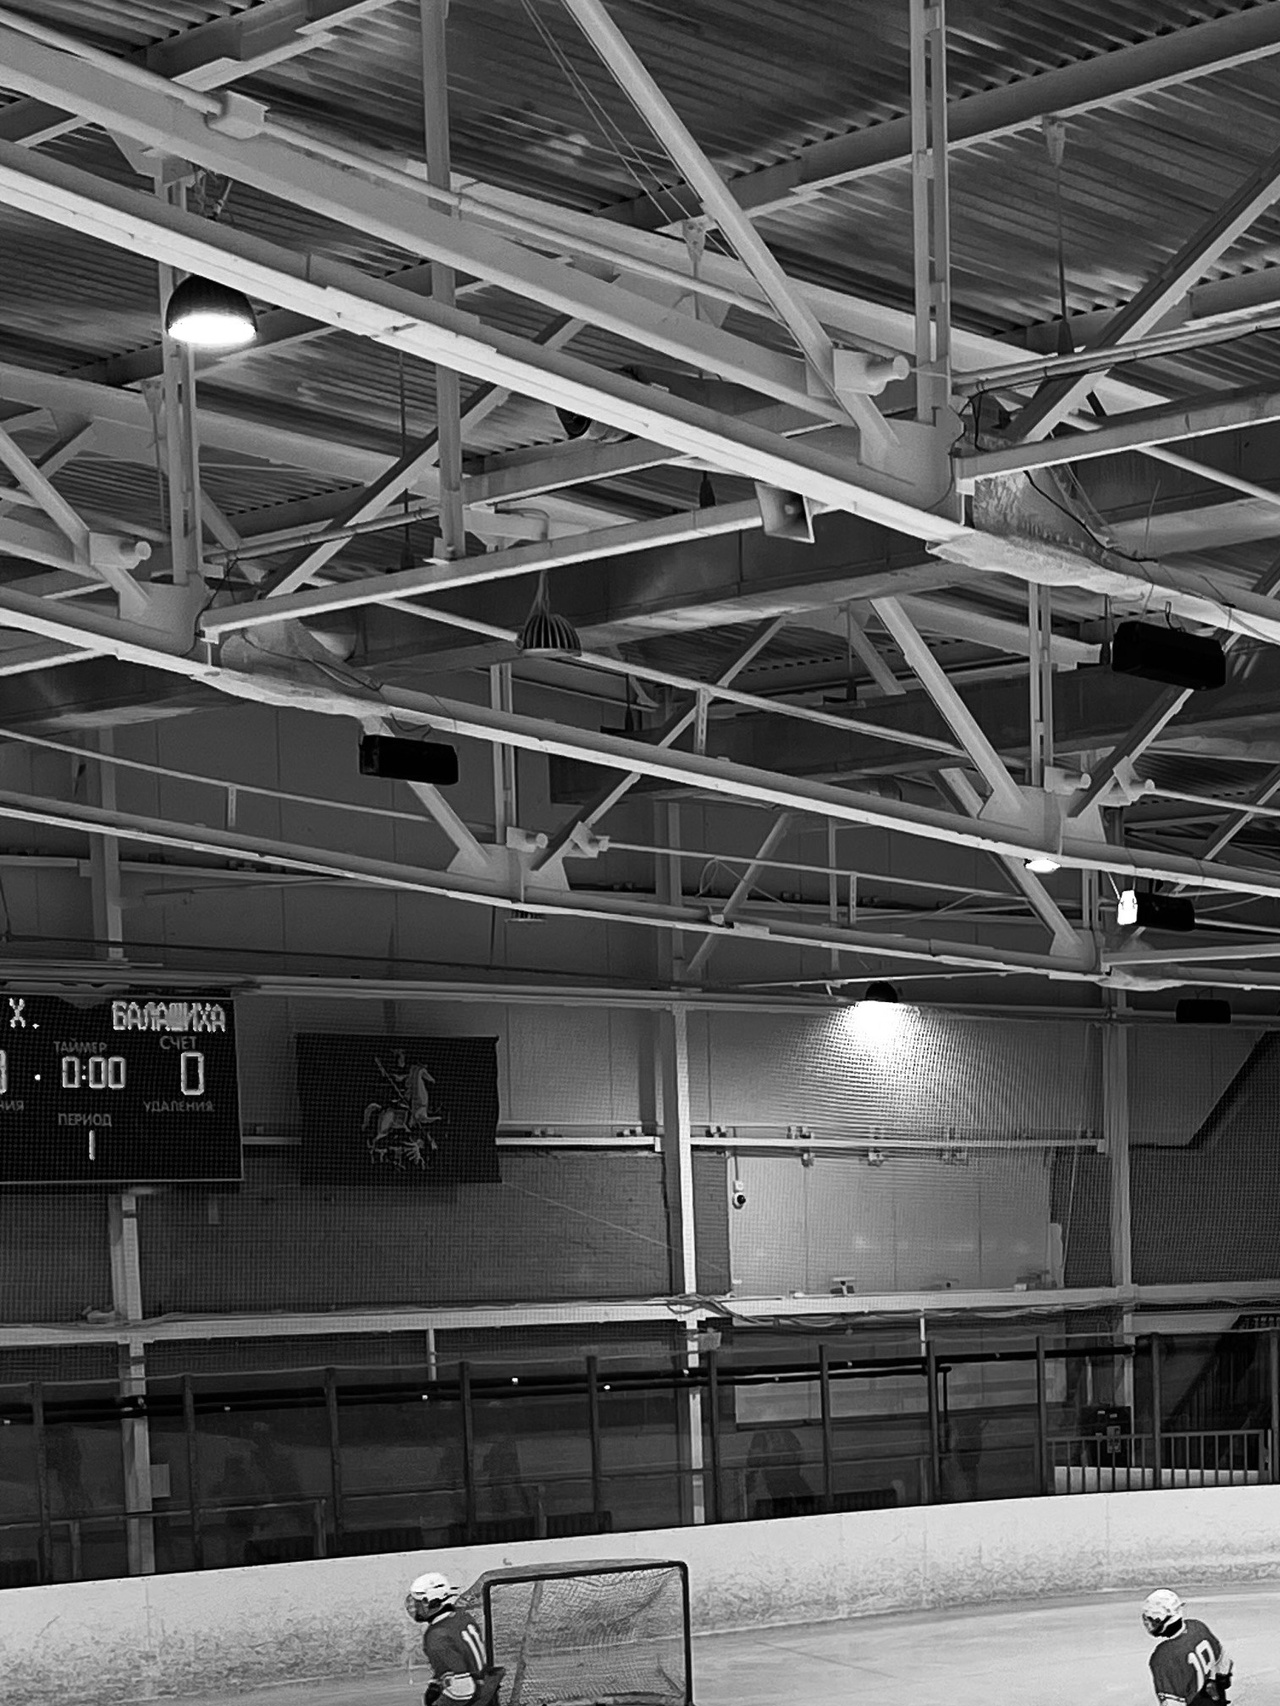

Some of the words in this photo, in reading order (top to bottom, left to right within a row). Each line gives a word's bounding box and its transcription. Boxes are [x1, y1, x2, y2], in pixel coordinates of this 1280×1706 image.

[53, 1038, 107, 1054] ТАЙМЕР
[160, 1035, 197, 1050] СЧЕТ
[62, 1056, 126, 1089] 0:00
[181, 1052, 204, 1095] 0
[143, 1101, 214, 1112] УДАЛЕНИЯ
[57, 1112, 112, 1127] ПЕРИОД
